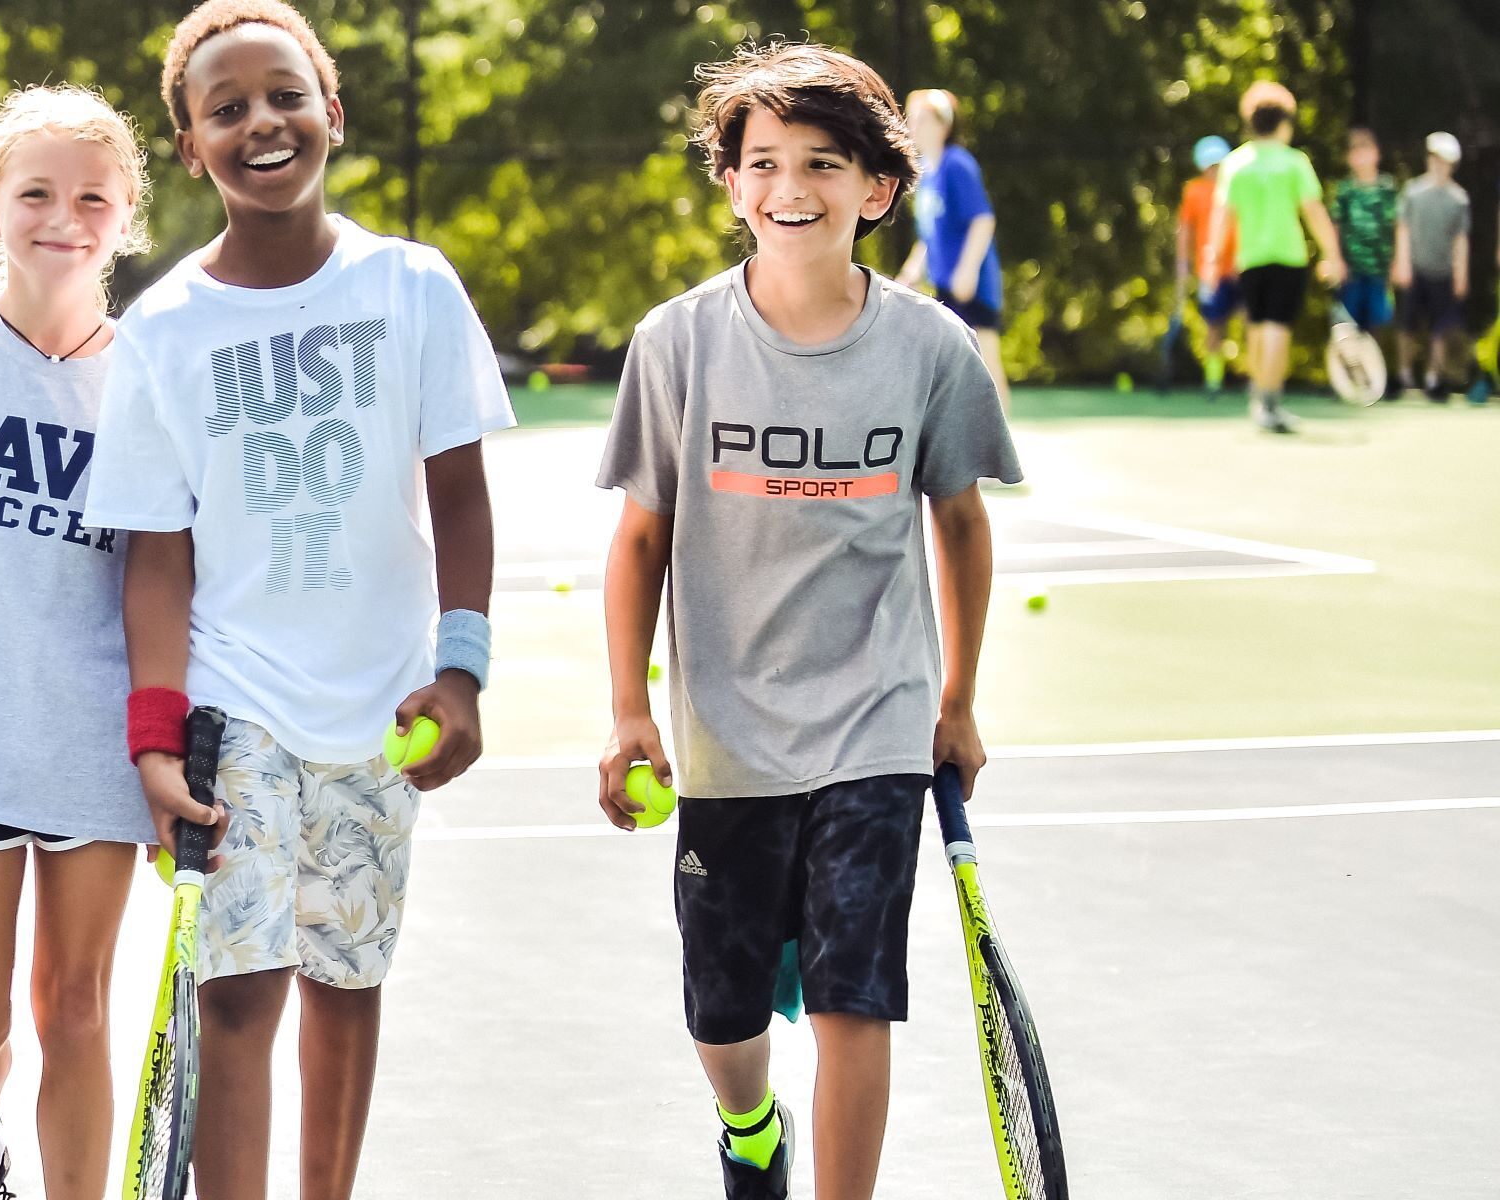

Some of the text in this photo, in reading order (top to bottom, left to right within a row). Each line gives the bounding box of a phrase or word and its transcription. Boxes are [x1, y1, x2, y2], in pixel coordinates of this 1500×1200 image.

[205, 318, 386, 438] JUST
[244, 418, 365, 515] DO
[711, 421, 903, 469] POLO
[766, 479, 854, 497] SPORT
[266, 510, 353, 595] IT.
[679, 864, 707, 877] adidas
